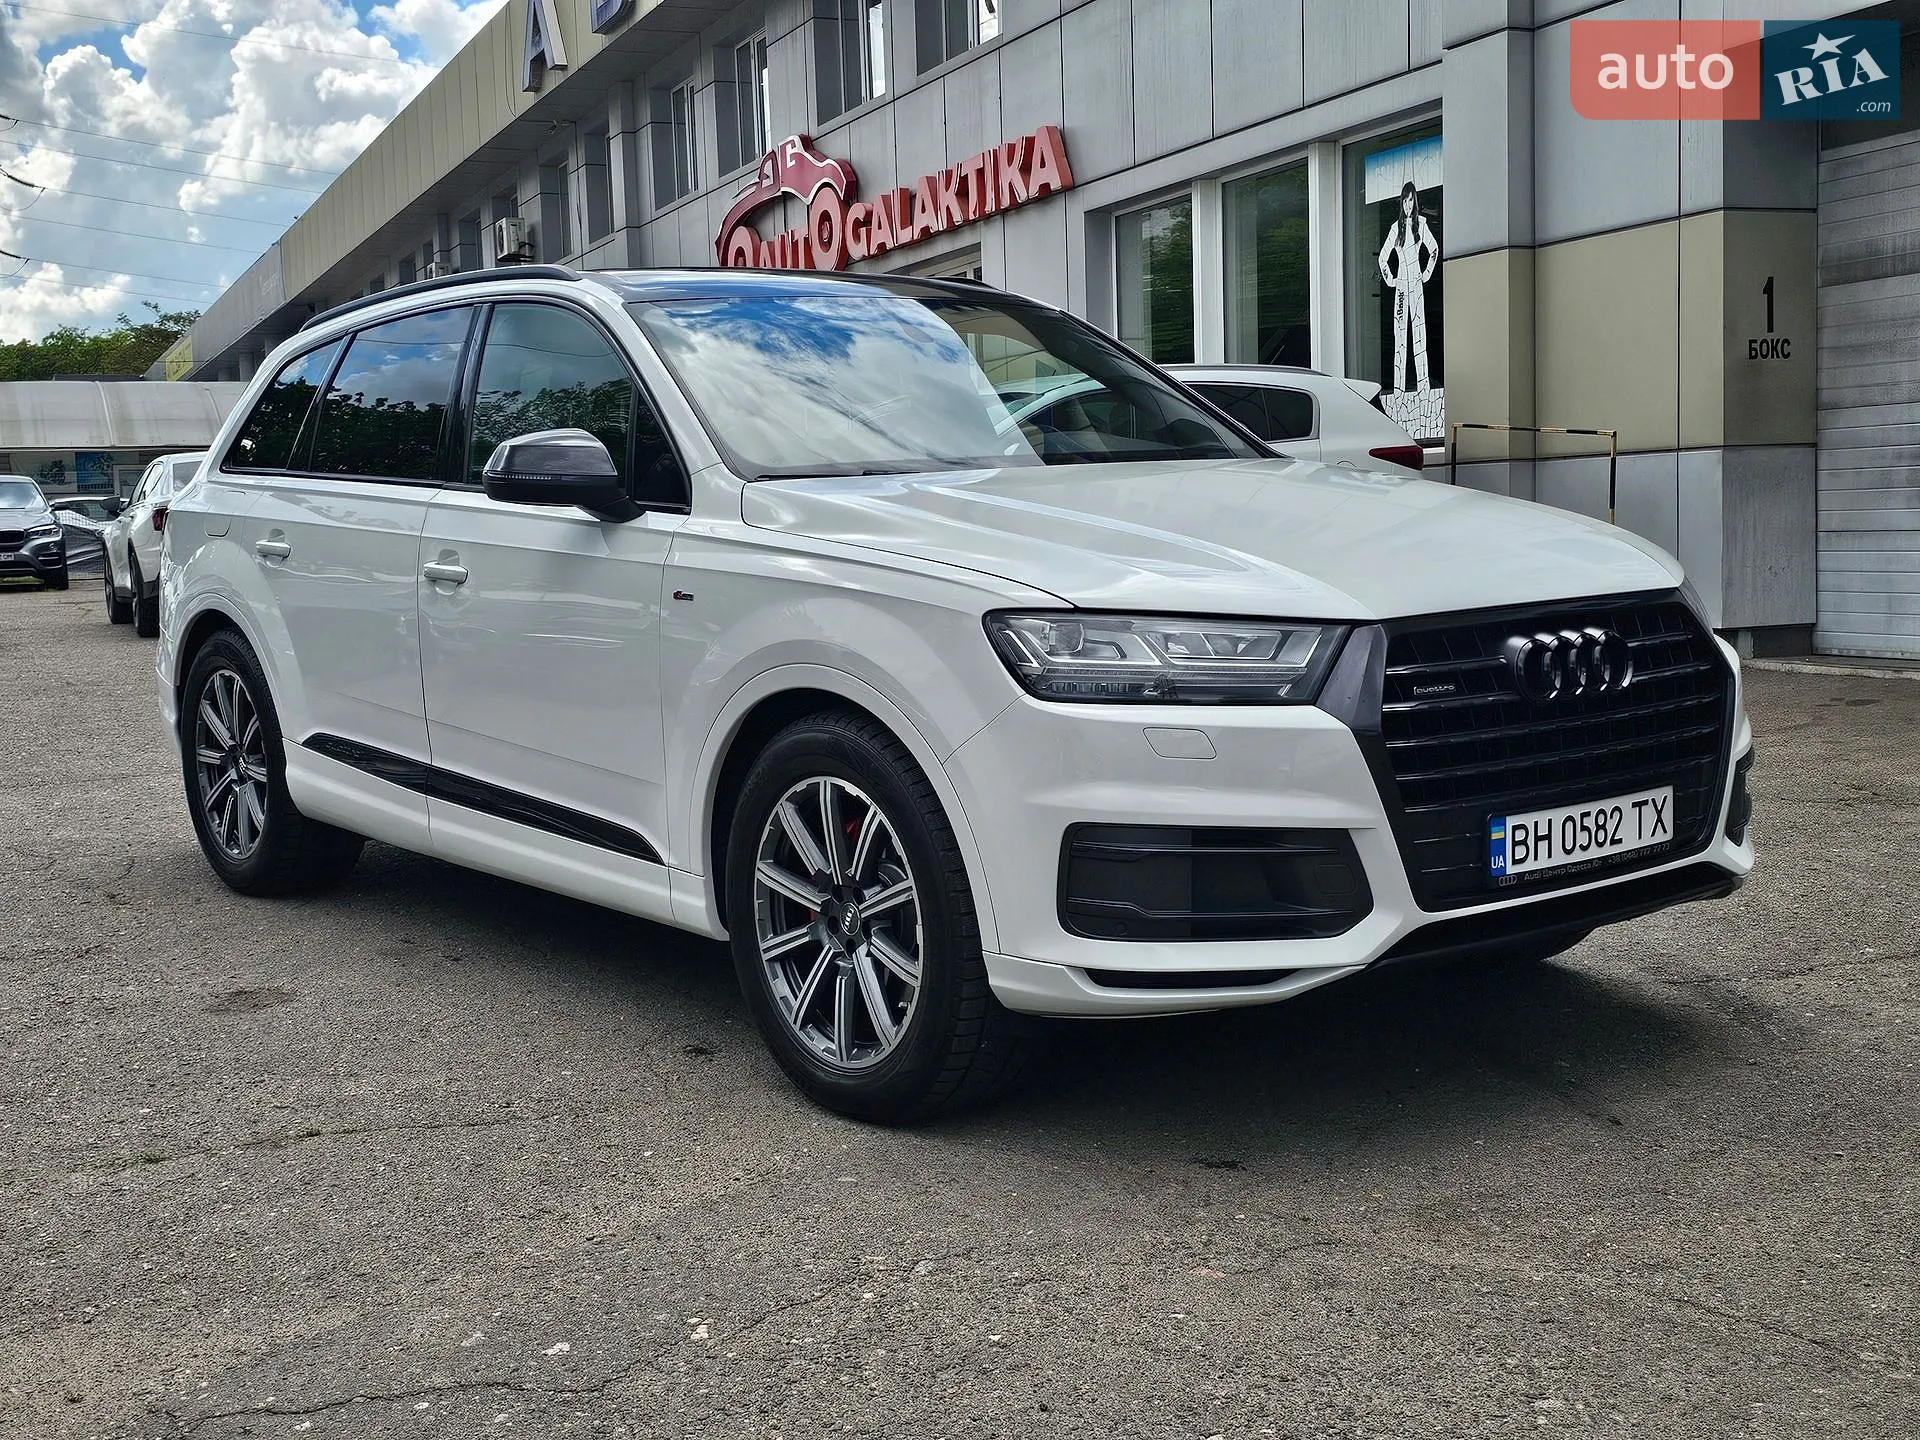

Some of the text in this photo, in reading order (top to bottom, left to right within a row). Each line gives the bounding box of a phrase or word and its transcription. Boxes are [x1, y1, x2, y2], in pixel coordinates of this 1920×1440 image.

[1762, 276, 1774, 333] 1
[1748, 338, 1791, 360] БОКС
[1511, 795, 1668, 866] BH 0582 TX
[1491, 855, 1505, 869] UA
[1524, 871, 1542, 881] Audi
